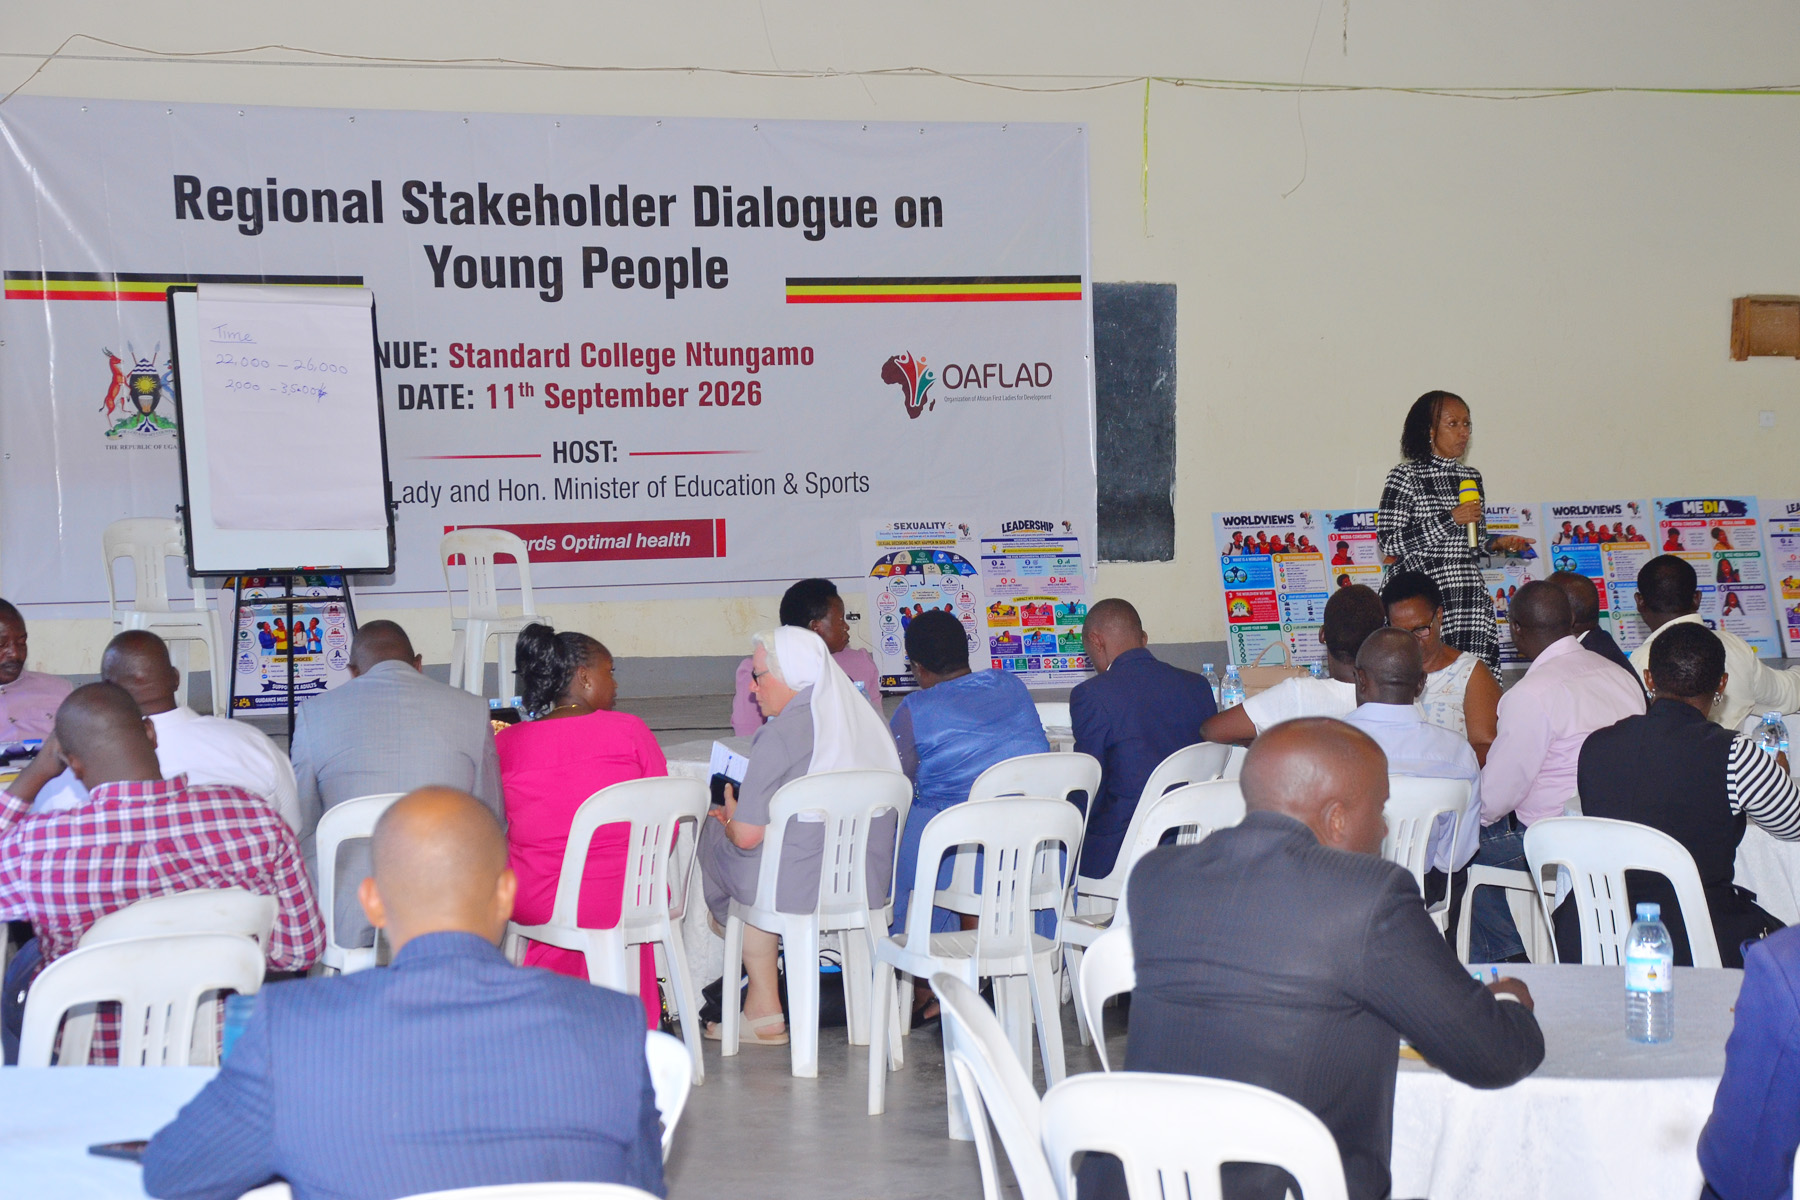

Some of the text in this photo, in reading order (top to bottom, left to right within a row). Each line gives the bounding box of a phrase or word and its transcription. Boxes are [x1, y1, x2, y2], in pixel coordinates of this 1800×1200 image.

[173, 174, 943, 242] Regional Stakeholder Dialogue on
[423, 244, 729, 303] Young People
[212, 323, 253, 342] Time
[377, 341, 814, 375] NUE: Standard College Ntungamo
[942, 362, 1053, 389] OAFLAD
[397, 383, 474, 410] DATE:
[544, 382, 689, 415] September
[698, 380, 762, 407] 2026
[552, 440, 618, 464] HOST:
[450, 479, 490, 503] and
[498, 478, 546, 501] Hon.
[554, 477, 640, 501] Minister
[647, 475, 667, 498] of
[674, 473, 776, 497] Education
[783, 472, 799, 495] &
[805, 471, 870, 499] Sports
[1485, 506, 1511, 514] ALITY
[1552, 504, 1622, 516] WORLDVIEWS
[1682, 500, 1729, 514] MEDIA
[893, 521, 946, 530] SEXUALITY
[1001, 520, 1054, 534] LEADERSHIP
[1222, 514, 1294, 526] WORLDVIEWS
[561, 533, 632, 553] Optimal
[636, 532, 691, 548] health
